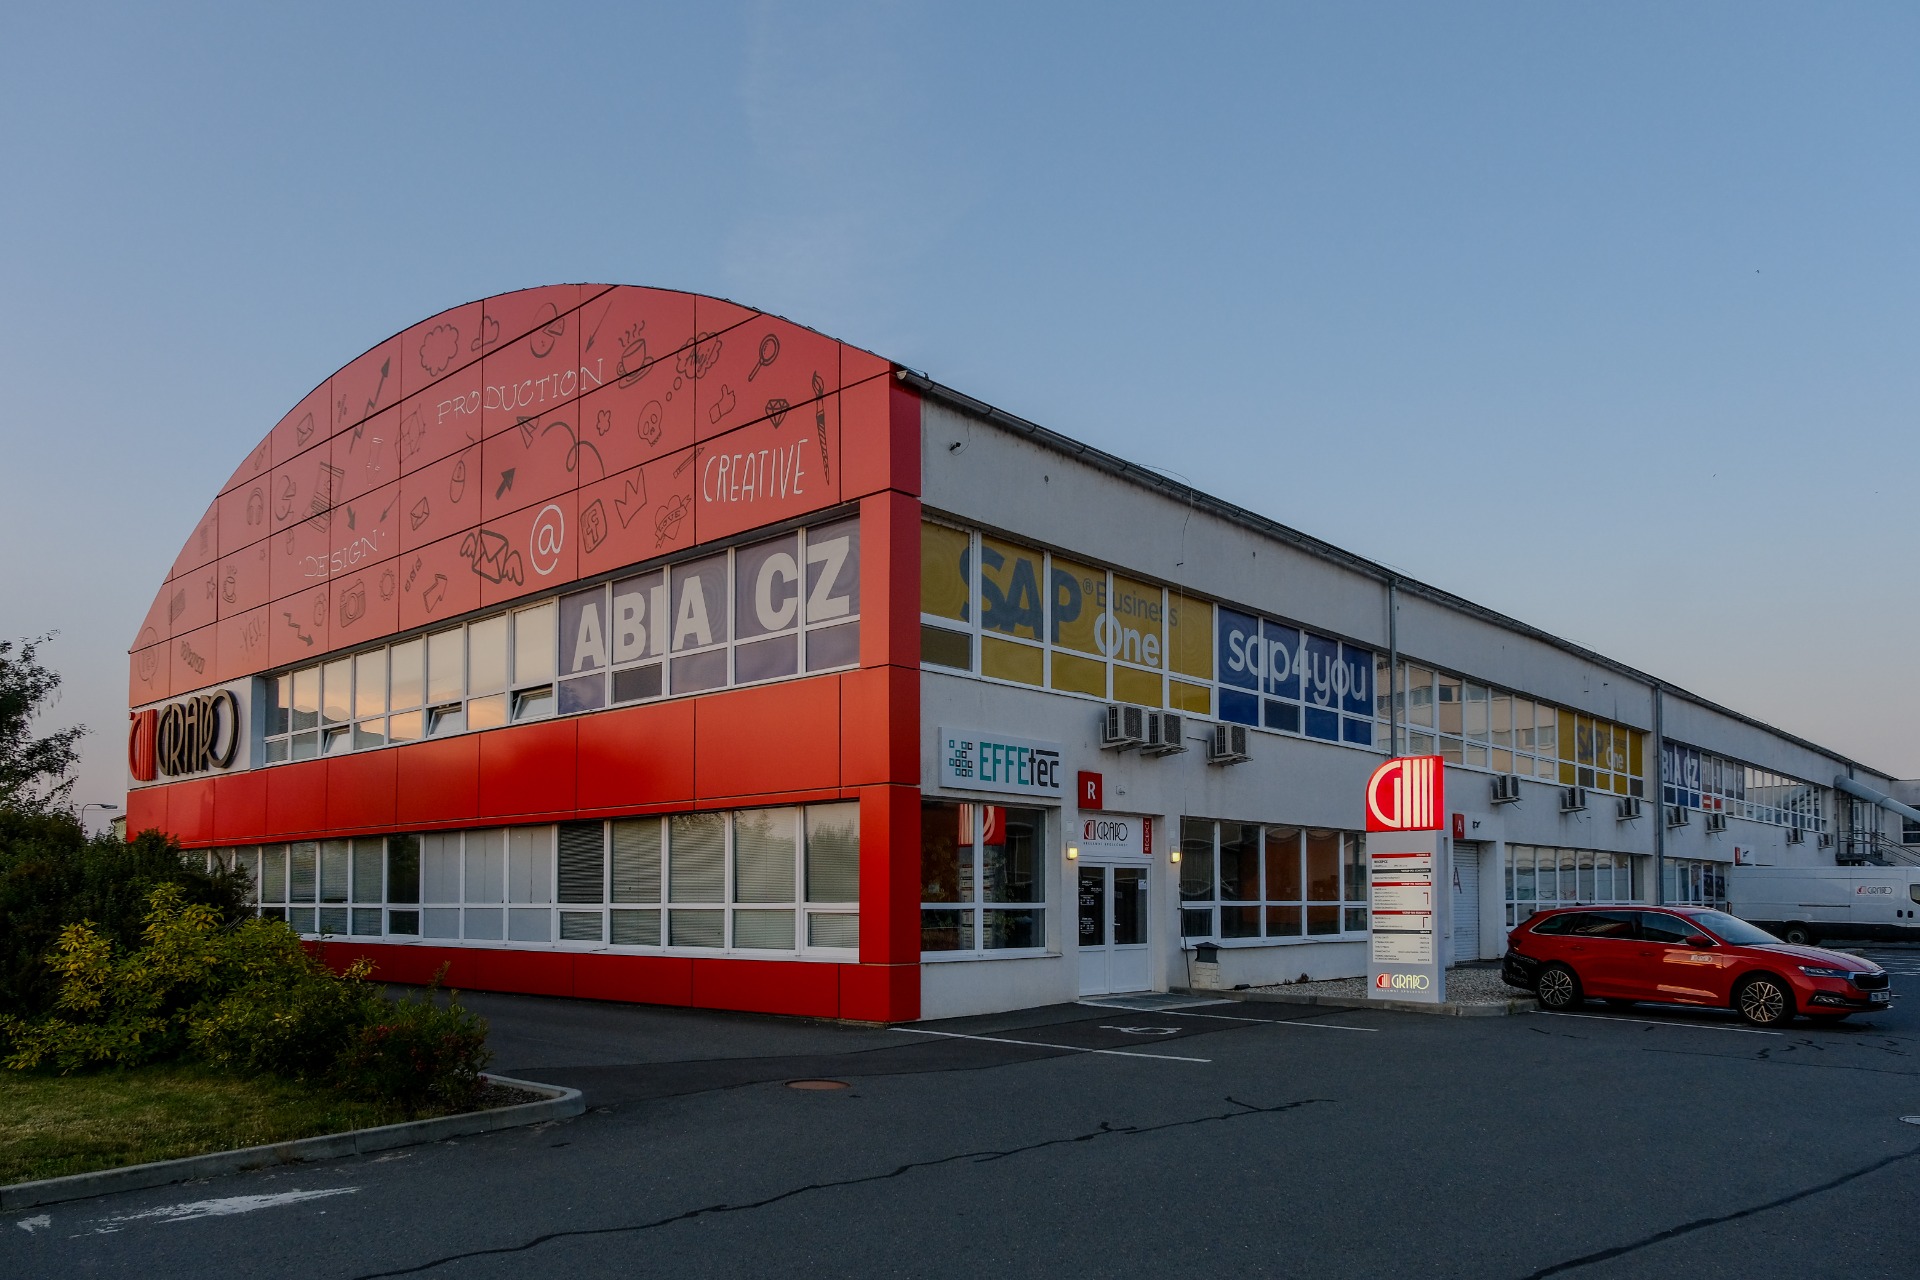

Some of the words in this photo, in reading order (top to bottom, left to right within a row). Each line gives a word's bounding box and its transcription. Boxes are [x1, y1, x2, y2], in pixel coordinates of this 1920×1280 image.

[436, 357, 604, 425] PRODUCTION
[703, 438, 808, 503] CREATIVE
[658, 510, 681, 532] LOVE
[571, 574, 714, 674] ABIA
[754, 534, 851, 631] CZ
[1096, 580, 1178, 627] Busines
[1094, 612, 1161, 666] One
[1227, 628, 1368, 706] sap4you
[156, 688, 241, 777] GRAPO
[1087, 780, 1097, 800] R
[1096, 821, 1128, 842] GRAPO
[1457, 819, 1463, 833] A
[1391, 974, 1430, 990] GRAPO
